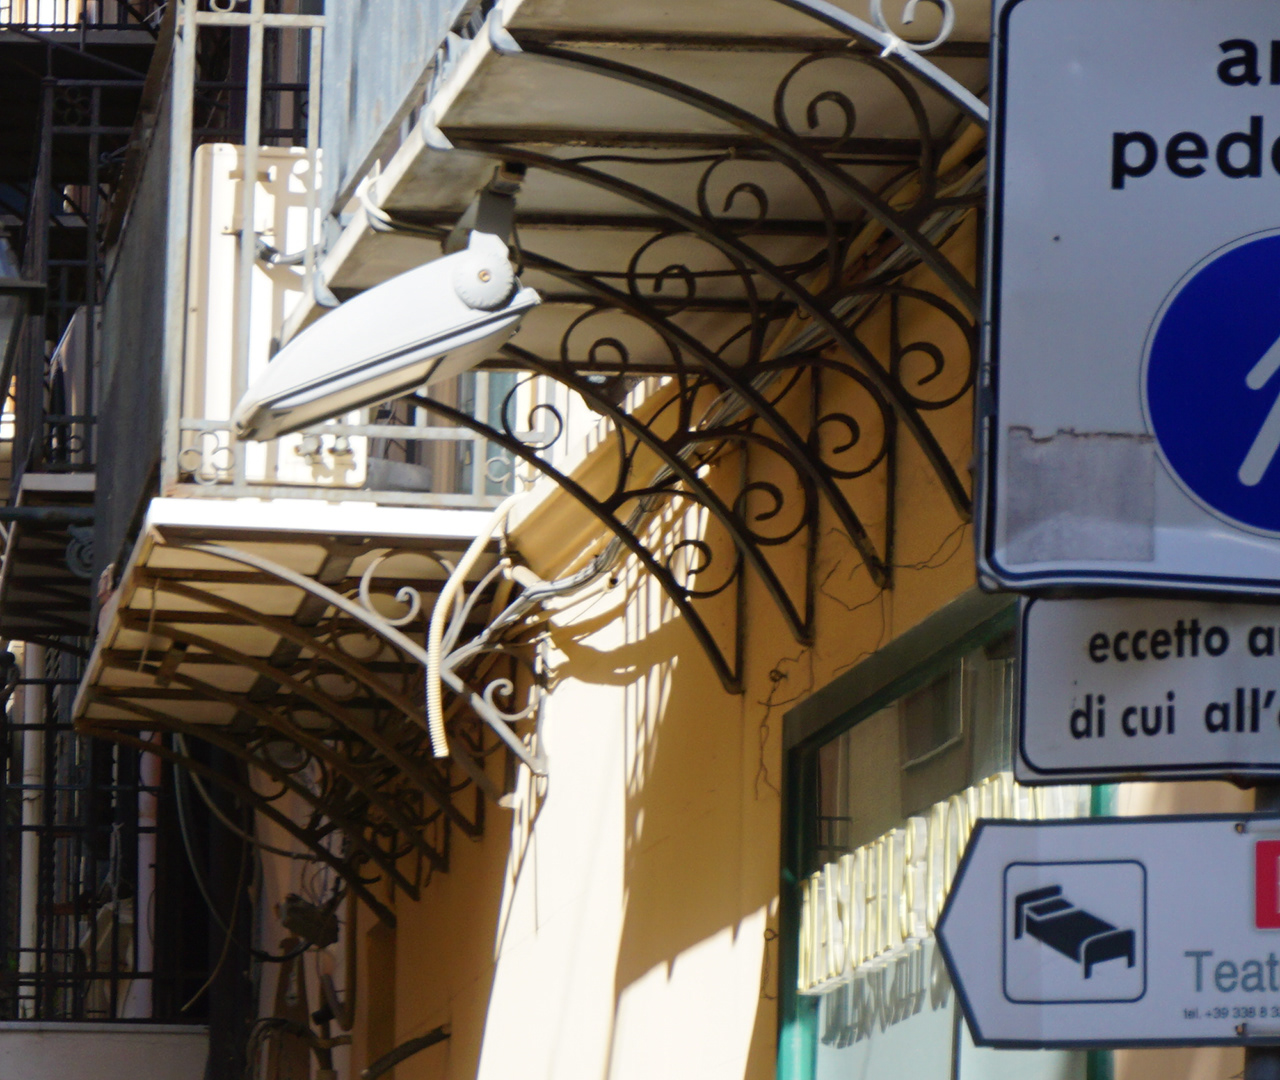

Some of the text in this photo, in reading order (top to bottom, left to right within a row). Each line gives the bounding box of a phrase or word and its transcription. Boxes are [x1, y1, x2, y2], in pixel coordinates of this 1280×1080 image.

[1111, 115, 1280, 190] ped
[1089, 618, 1280, 663] eccetto a
[1070, 687, 1280, 739] di cui all'
[1205, 1007, 1228, 1019] +39
